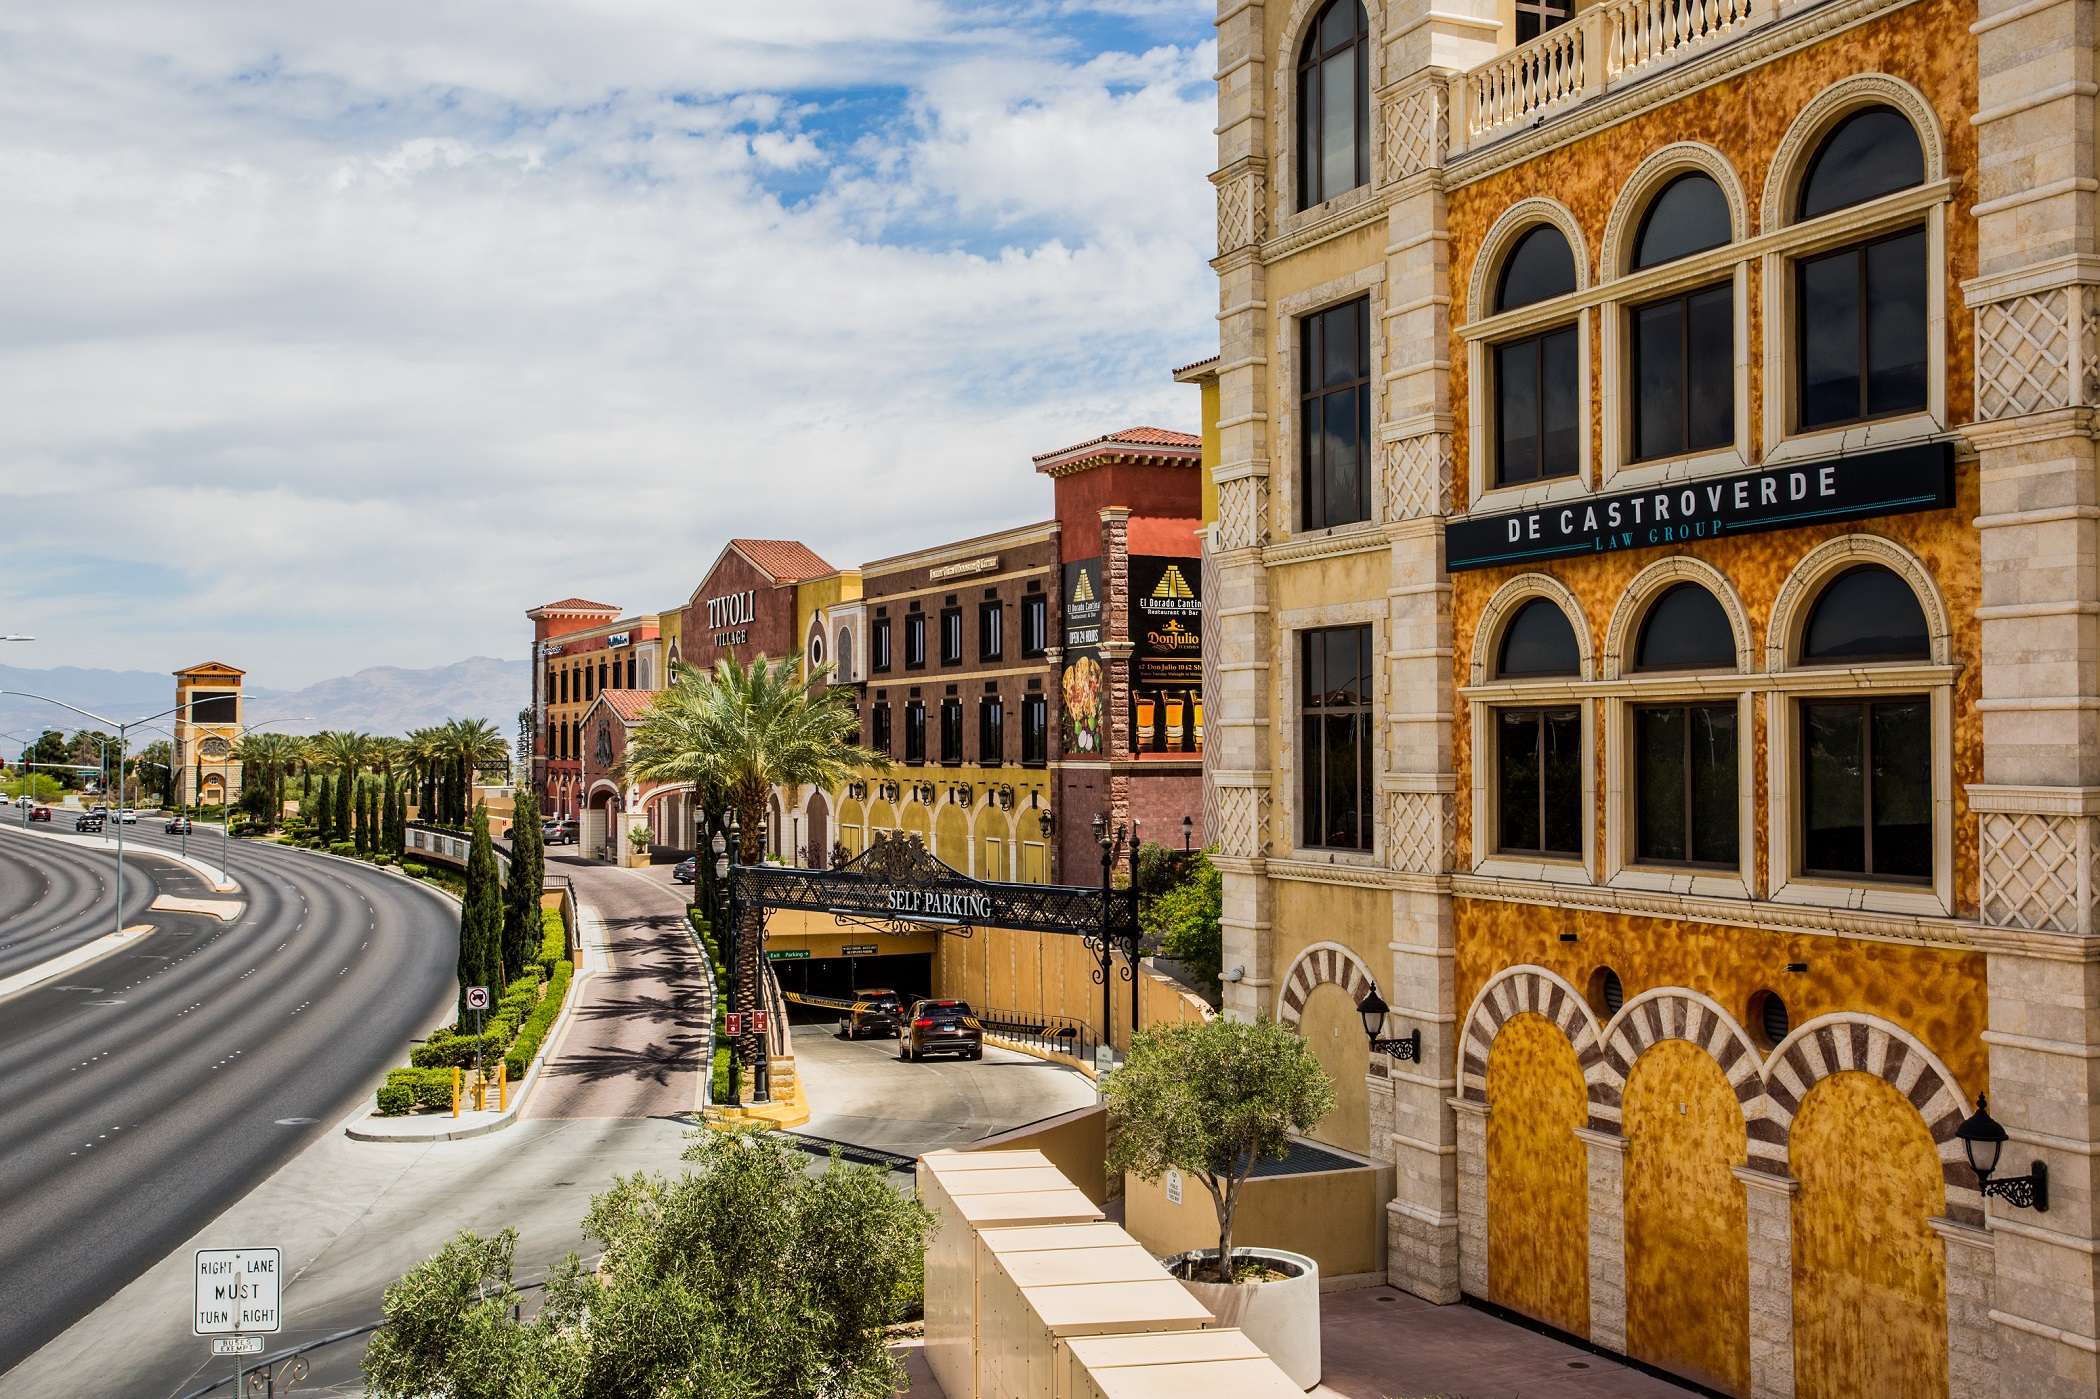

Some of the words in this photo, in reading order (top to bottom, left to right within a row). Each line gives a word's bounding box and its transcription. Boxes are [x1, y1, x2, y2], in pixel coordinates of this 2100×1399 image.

[1508, 515, 1541, 543] DE
[1560, 466, 1836, 535] CASTROVERDE
[1595, 531, 1634, 551] LAW
[1649, 520, 1722, 544] GROUP
[707, 589, 756, 630] TIVOLI
[1140, 598, 1147, 607] El
[1149, 598, 1175, 608] Dorado
[1177, 598, 1202, 608] Cantin
[1147, 608, 1180, 616] Restaurant
[714, 629, 748, 647] VILLAGE
[1069, 631, 1080, 645] OPEN
[1080, 630, 1086, 644] 24
[1086, 629, 1099, 643] HOURS
[888, 889, 922, 911] SELF
[924, 892, 992, 918] PARKING
[201, 1261, 233, 1275] RIGHT
[247, 1260, 274, 1273] LANE
[215, 1283, 259, 1300] MUST
[200, 1311, 228, 1324] TURN
[243, 1309, 275, 1322] RIGHT
[222, 1338, 252, 1346] BUSES
